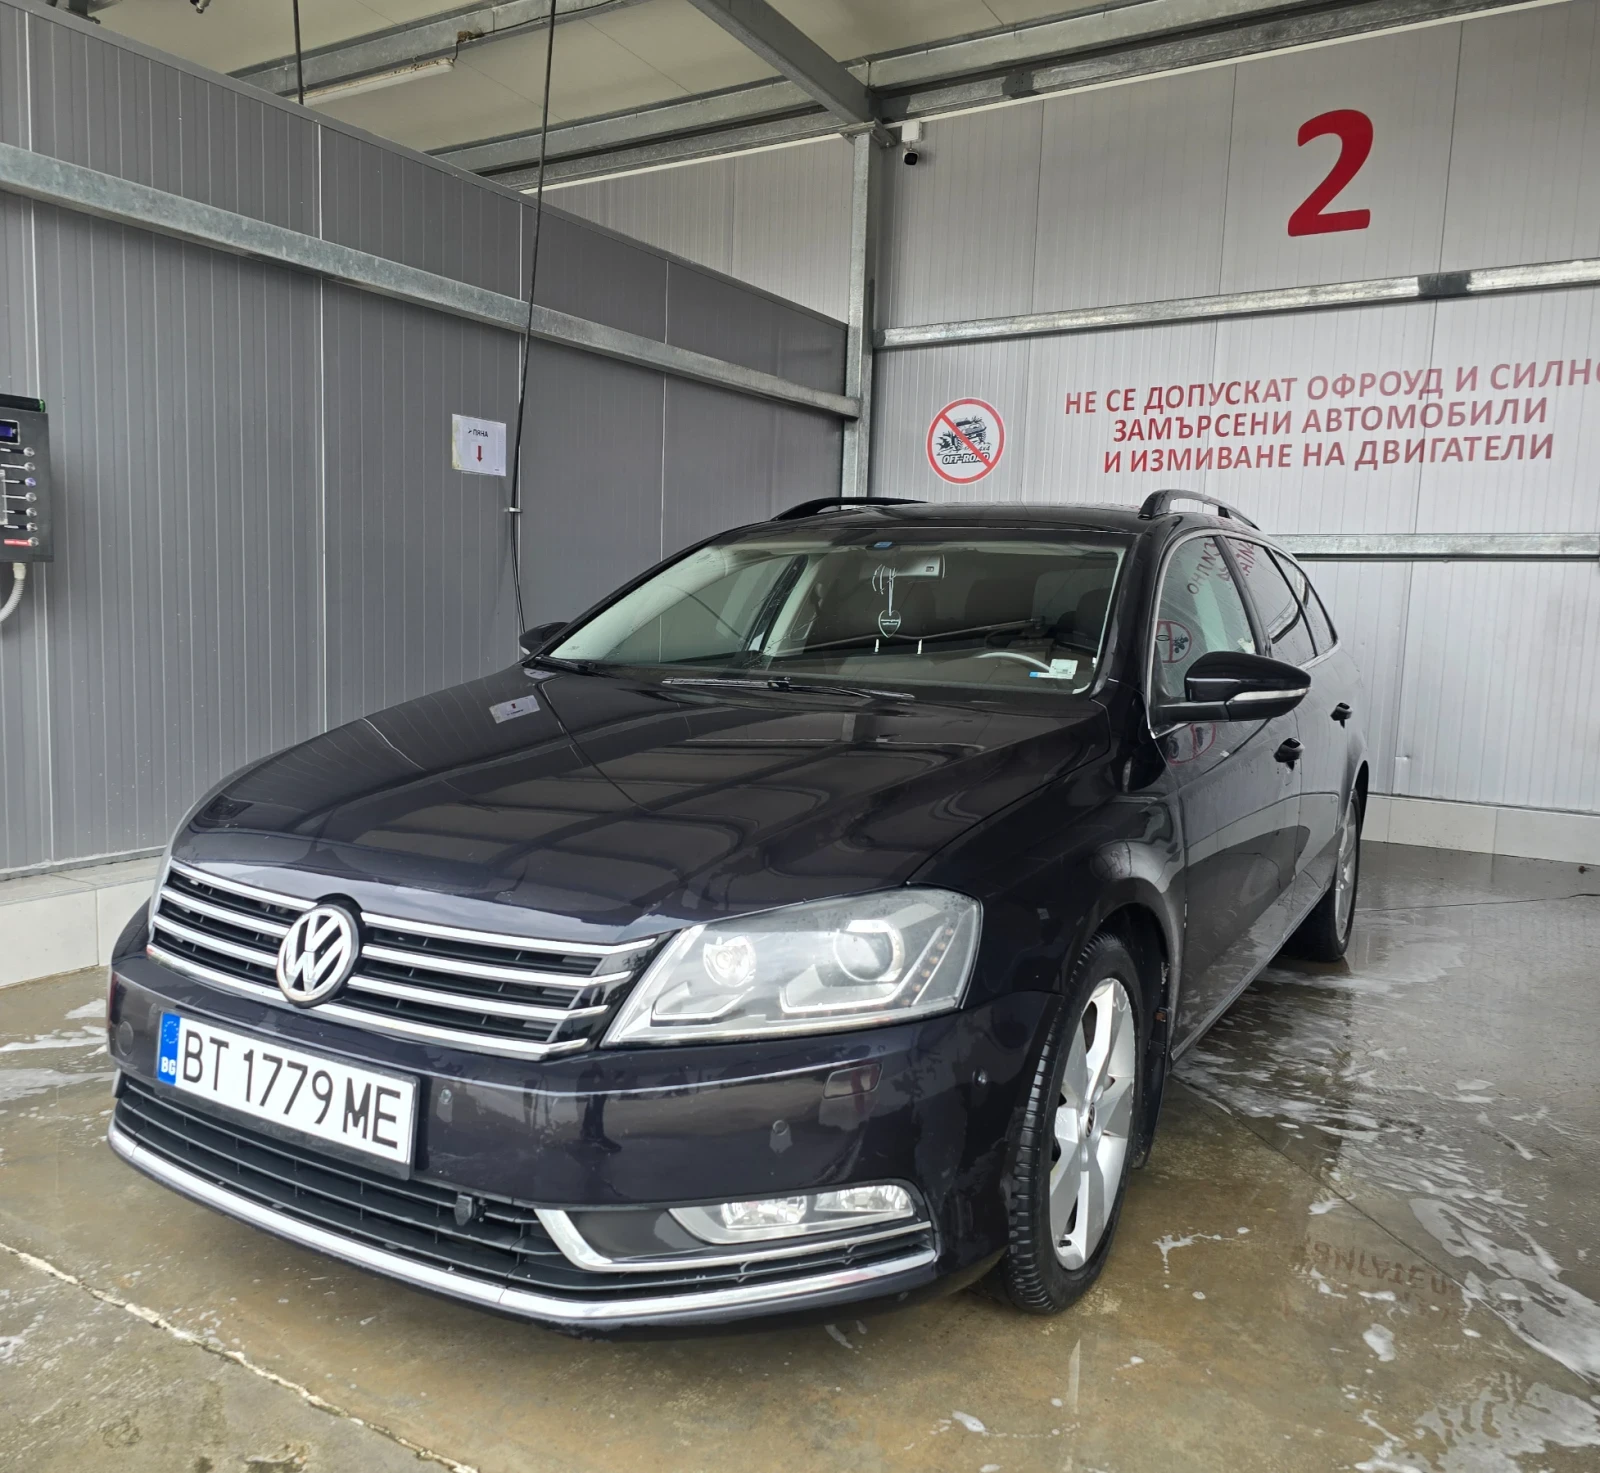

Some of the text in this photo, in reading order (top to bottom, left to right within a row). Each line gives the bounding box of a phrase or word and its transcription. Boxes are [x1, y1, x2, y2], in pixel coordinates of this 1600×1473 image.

[1287, 109, 1374, 237] 2
[1065, 391, 1097, 414] НЕ
[1106, 388, 1136, 412] СЕ
[1143, 377, 1298, 415] ДОПУСКАТ
[1307, 366, 1443, 400] ОФРОУД
[1455, 366, 1478, 392] И
[1113, 397, 1547, 442] ЗАМЪРСЕНИ АВТОМОБИЛИ
[1104, 433, 1553, 473] И ИЗМИВАНЕ НА ДВИГАТЕЛИ
[161, 1056, 176, 1076] BG
[243, 1048, 334, 1125] 1779
